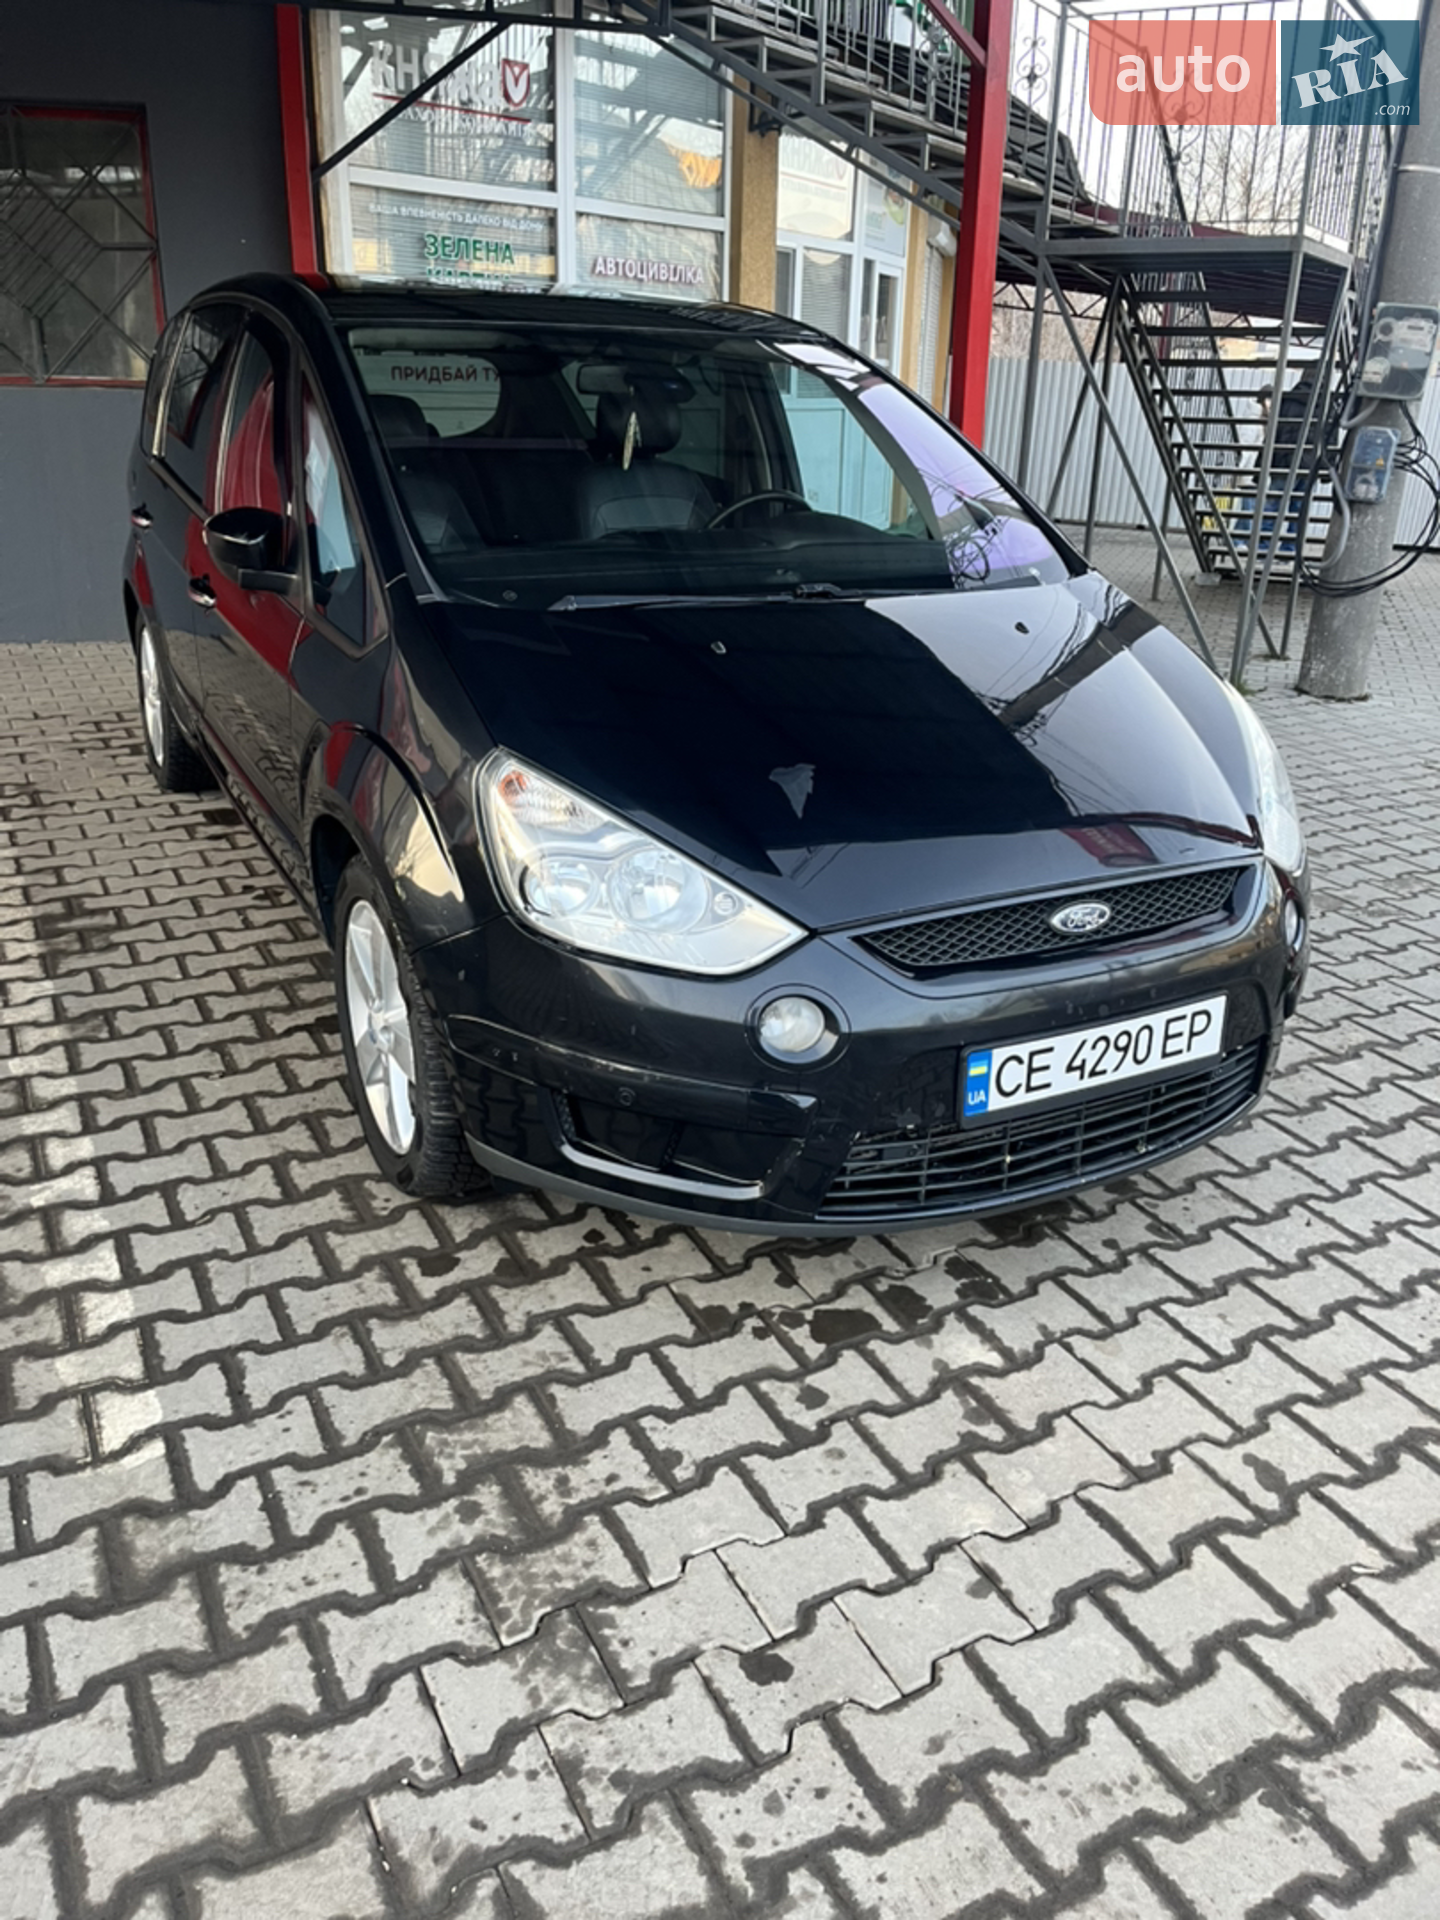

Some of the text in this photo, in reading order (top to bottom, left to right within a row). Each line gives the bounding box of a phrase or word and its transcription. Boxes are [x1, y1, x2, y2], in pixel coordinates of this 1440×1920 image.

[464, 212, 500, 227] ДАЛЕКО
[424, 232, 515, 265] ЗЕЛЕНА
[594, 255, 705, 284] АВТОЦИВІЛКА
[391, 364, 477, 385] ПРИДБАЙ
[995, 1008, 1212, 1098] CE 4290 EP
[967, 1089, 987, 1106] UA
